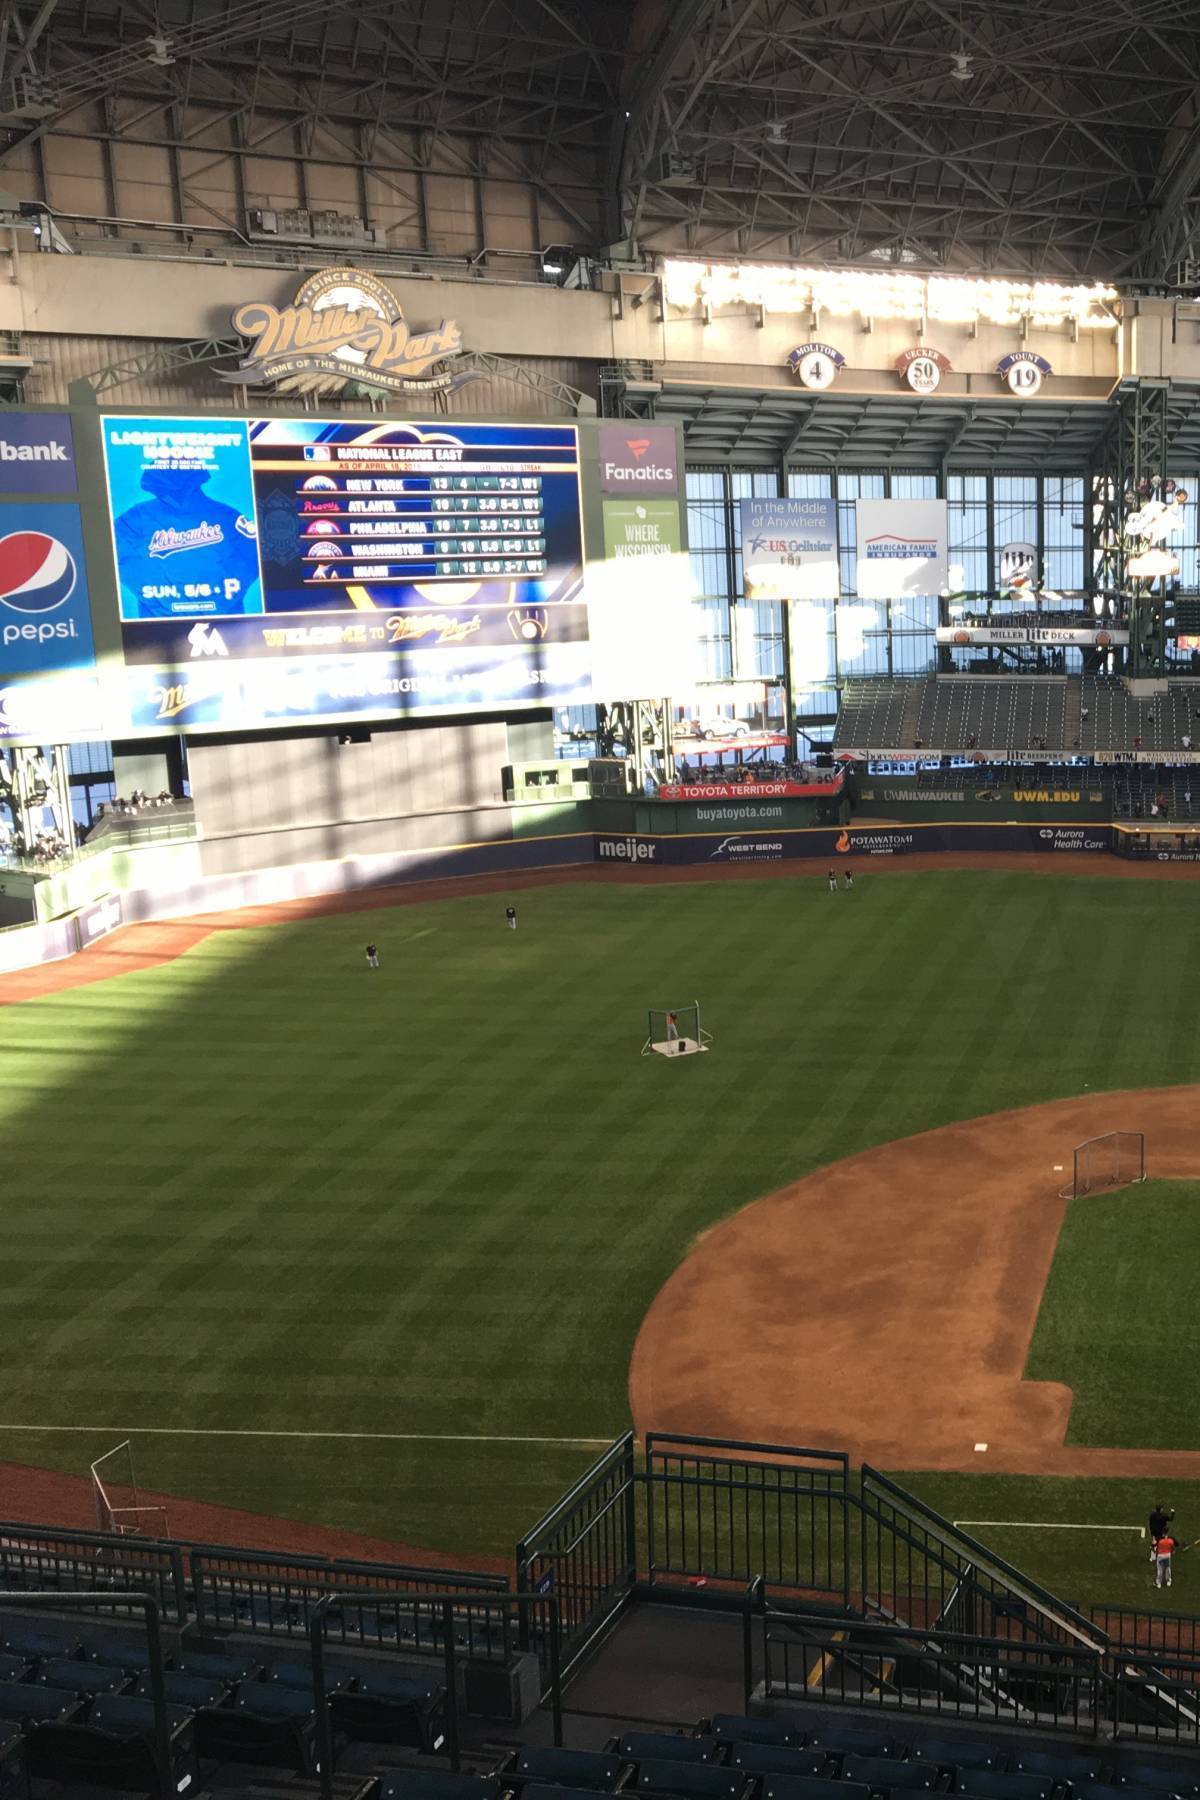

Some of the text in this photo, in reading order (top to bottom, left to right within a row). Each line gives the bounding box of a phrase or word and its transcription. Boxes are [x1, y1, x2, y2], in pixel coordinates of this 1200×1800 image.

[312, 271, 382, 296] SINCE 2001
[235, 303, 462, 369] Miller Park
[796, 344, 837, 358] MOLITOR
[905, 348, 940, 361] UECKER
[1009, 352, 1039, 364] YOUNT
[264, 359, 453, 391] HOME OF THE MILWAUKEE BREWERS
[809, 361, 822, 380] 4
[913, 362, 933, 380] 50
[1013, 369, 1037, 387] 19
[1, 440, 67, 461] bank
[338, 447, 463, 461] NATIONAL LEAGUE EAST
[605, 463, 673, 481] Fanatics
[346, 479, 372, 491] NEW
[460, 478, 468, 489] 4
[499, 478, 518, 489] 7-3
[522, 478, 538, 489] W1
[348, 500, 396, 512] ATLANTA
[462, 499, 469, 510] 7
[523, 499, 539, 510] W1
[751, 502, 827, 513] In the Middle
[463, 520, 470, 531] 7
[502, 520, 520, 531] 7-3
[526, 520, 539, 531] L1
[752, 517, 826, 530] of Anywhere
[149, 521, 223, 553] Milwaukee
[625, 524, 660, 542] WHERE
[527, 542, 540, 552] L1
[615, 543, 672, 558] WISCONSIN
[769, 540, 832, 552] US Cellular
[867, 543, 937, 551] AMERICAN FAMILY
[526, 561, 543, 572] W1
[3, 618, 75, 645] pepsi
[369, 626, 385, 640] TO
[990, 631, 1024, 640] MILLER
[1051, 632, 1075, 640] DECK
[1114, 752, 1137, 761] WTMJ
[683, 784, 787, 797] TOYOTA TERRITORY
[1014, 791, 1080, 802] UWM.EDU
[697, 806, 782, 820] buyatoyota.com
[851, 835, 913, 845] POTAWATOMI
[1055, 830, 1084, 838] Aurora
[599, 838, 655, 861] meijer
[728, 843, 782, 852] WEST BEND
[1054, 840, 1104, 848] Health Care
[1171, 853, 1194, 861] Aurora
